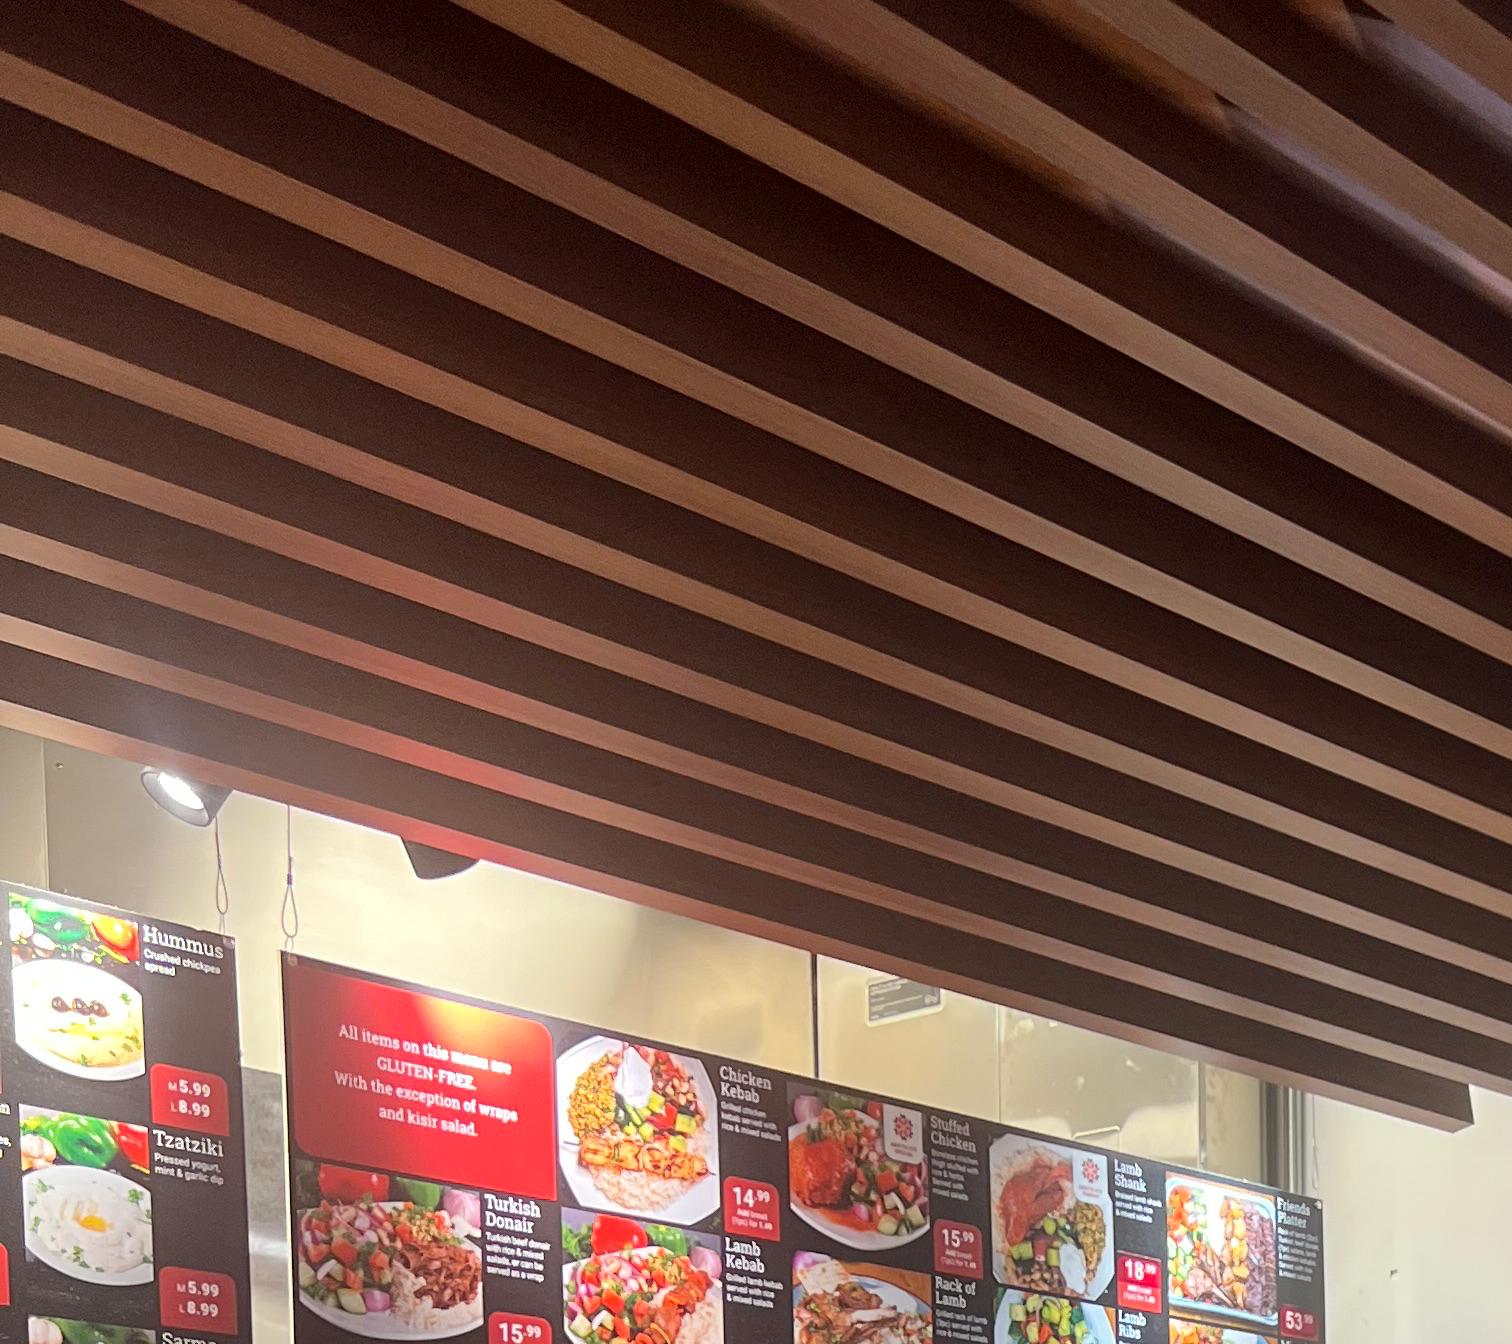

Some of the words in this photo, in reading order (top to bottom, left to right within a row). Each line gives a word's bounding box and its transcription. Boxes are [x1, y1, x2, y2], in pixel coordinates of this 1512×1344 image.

[143, 924, 224, 960] Hummus
[144, 948, 181, 966] Crushed
[145, 962, 176, 976] spread
[338, 1024, 358, 1040] All
[362, 1028, 400, 1050] items
[402, 1040, 420, 1054] on
[422, 1042, 449, 1061] this
[720, 1065, 772, 1090] Chicken
[168, 1080, 178, 1091] M
[178, 1080, 211, 1097] 5.99
[334, 1070, 368, 1090] With
[370, 1079, 392, 1095] the
[396, 1086, 460, 1110] exception
[464, 1098, 477, 1113] of
[479, 1102, 518, 1124] wraps
[720, 1082, 760, 1104] Kebab
[171, 1102, 177, 1112] L
[178, 1100, 210, 1117] 8.99
[379, 1106, 404, 1122] and
[407, 1109, 438, 1128] kisir
[442, 1118, 478, 1136] salad.
[930, 1115, 970, 1136] Stuffed
[153, 1130, 224, 1157] Tzatziki
[930, 1130, 976, 1153] Chicken
[154, 1152, 190, 1167] Pressed
[1114, 1158, 1142, 1178] Lamb
[155, 1165, 176, 1176] mint
[177, 1168, 184, 1178] &
[184, 1170, 210, 1183] garlic
[210, 1174, 224, 1186] dip
[1114, 1174, 1147, 1192] Shank
[484, 1193, 541, 1218] Turkish
[732, 1186, 770, 1208] 14.99
[1276, 1196, 1310, 1216] Friends
[484, 1211, 534, 1234] Donair
[1278, 1210, 1307, 1228] Platter
[724, 1236, 761, 1258] Lamb
[942, 1229, 974, 1248] 15.99
[725, 1253, 766, 1274] Kebab
[188, 1280, 220, 1298] 5.99
[935, 1276, 962, 1293] Rack
[964, 1282, 976, 1296] of
[179, 1304, 186, 1312] L
[187, 1300, 219, 1317] 8.99
[936, 1291, 966, 1308] Lamb
[1118, 1310, 1147, 1327] Lamb
[499, 1322, 542, 1344] 15.99
[1118, 1324, 1142, 1340] Ribs
